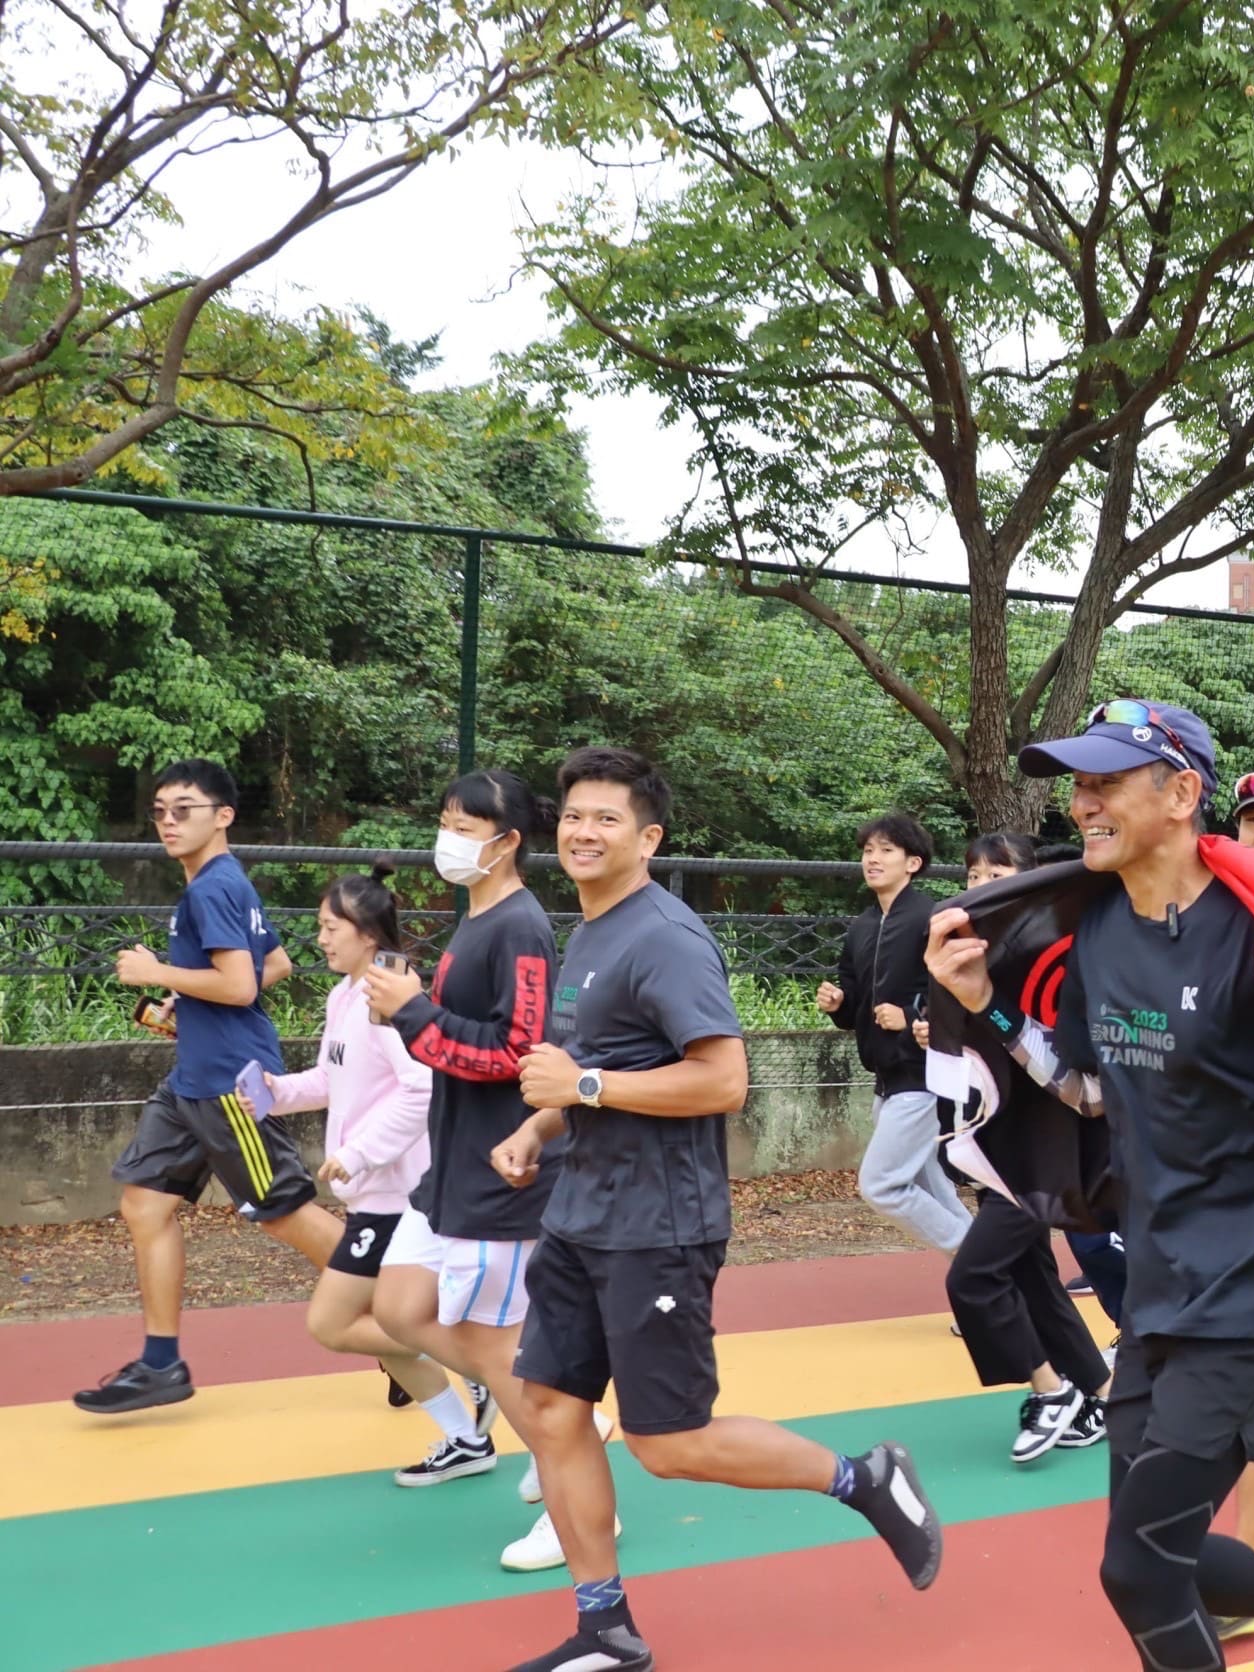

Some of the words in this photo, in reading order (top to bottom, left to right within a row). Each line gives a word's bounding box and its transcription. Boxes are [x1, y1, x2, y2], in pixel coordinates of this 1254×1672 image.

[517, 969, 537, 1051] MOUR
[1181, 986, 1198, 1011] K
[1130, 1009, 1168, 1031] 2023
[1091, 1023, 1176, 1051] RUNNING
[424, 1037, 505, 1073] UNDER
[1100, 1046, 1165, 1072] TAIWAN
[351, 1227, 376, 1258] 3
